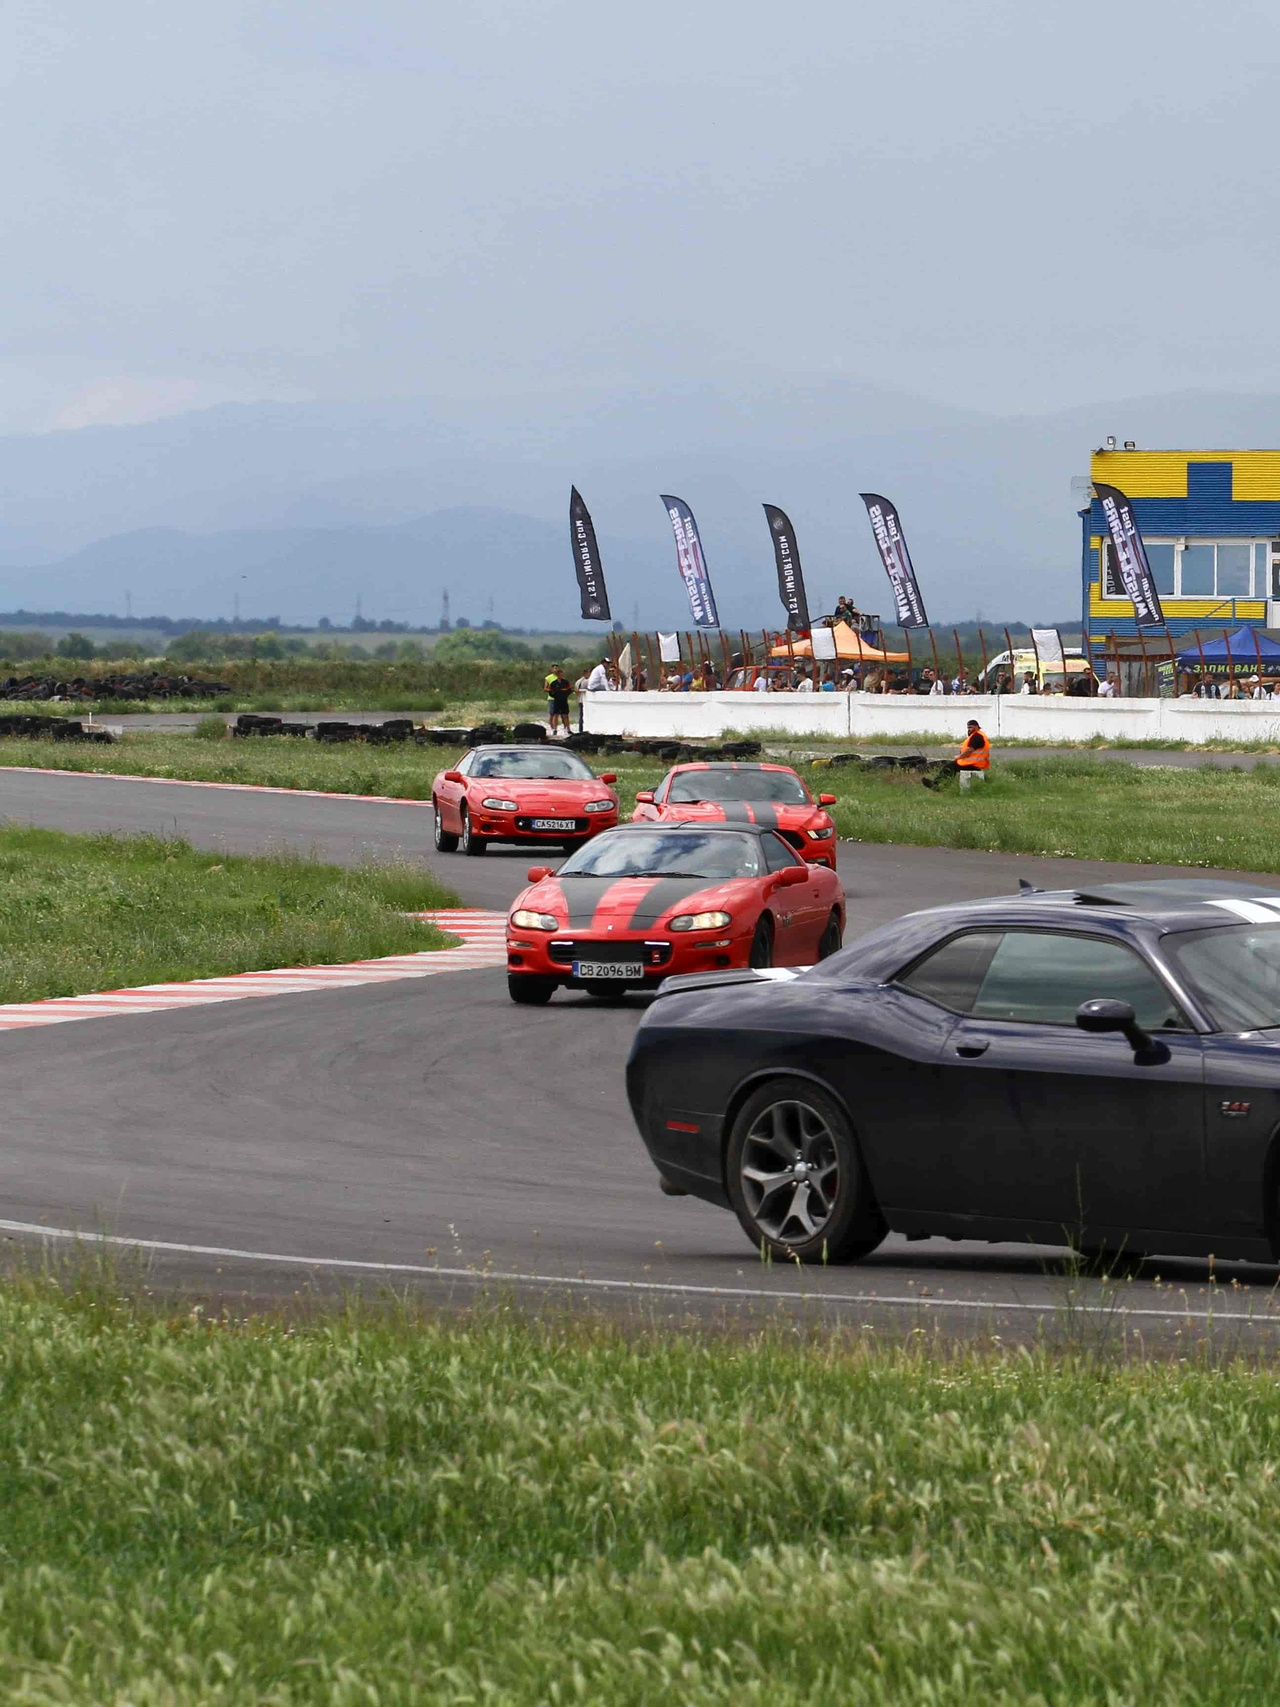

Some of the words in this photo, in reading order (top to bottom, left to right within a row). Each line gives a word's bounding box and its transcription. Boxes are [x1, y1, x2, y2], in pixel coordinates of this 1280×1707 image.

[580, 964, 594, 976] CB
[596, 965, 623, 977] 2096
[625, 965, 641, 977] BM
